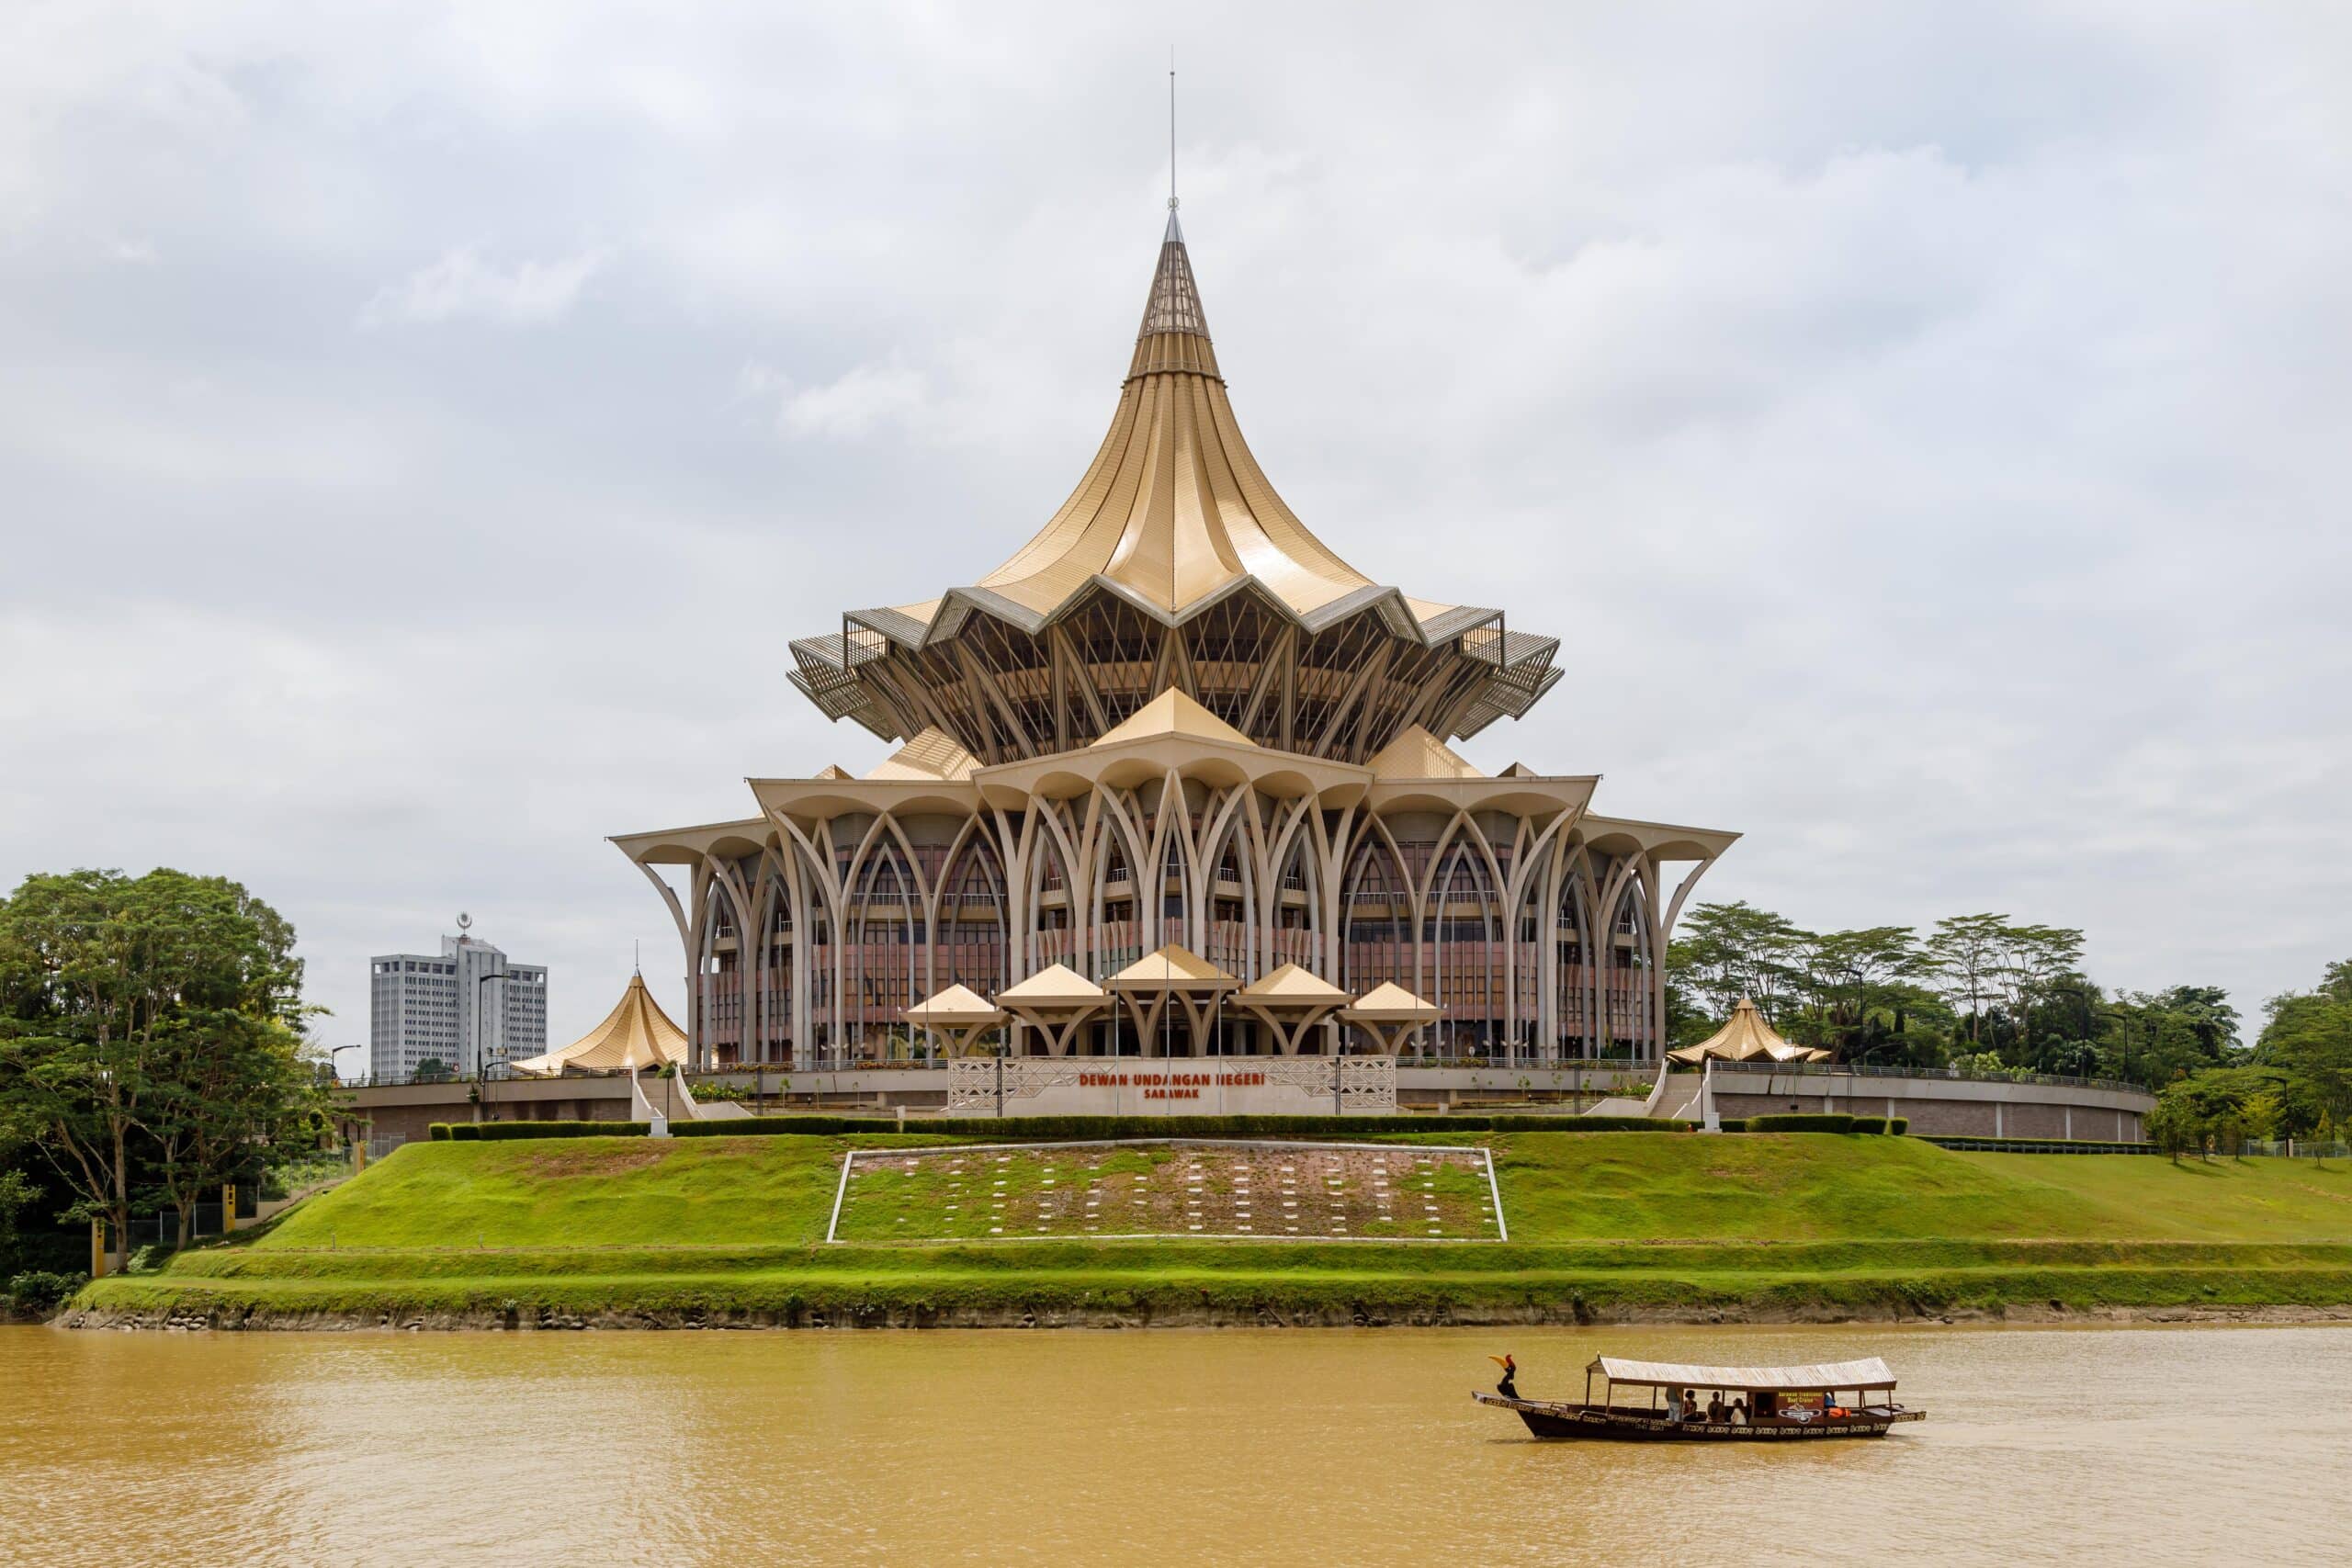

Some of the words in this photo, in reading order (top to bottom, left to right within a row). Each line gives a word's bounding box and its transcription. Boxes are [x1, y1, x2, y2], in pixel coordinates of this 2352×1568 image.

[1080, 1074, 1128, 1087] DEWAN
[1133, 1074, 1211, 1087] UNDANGAN
[1216, 1074, 1265, 1087] NEGERI
[1145, 1089, 1199, 1100] SARAWAK
